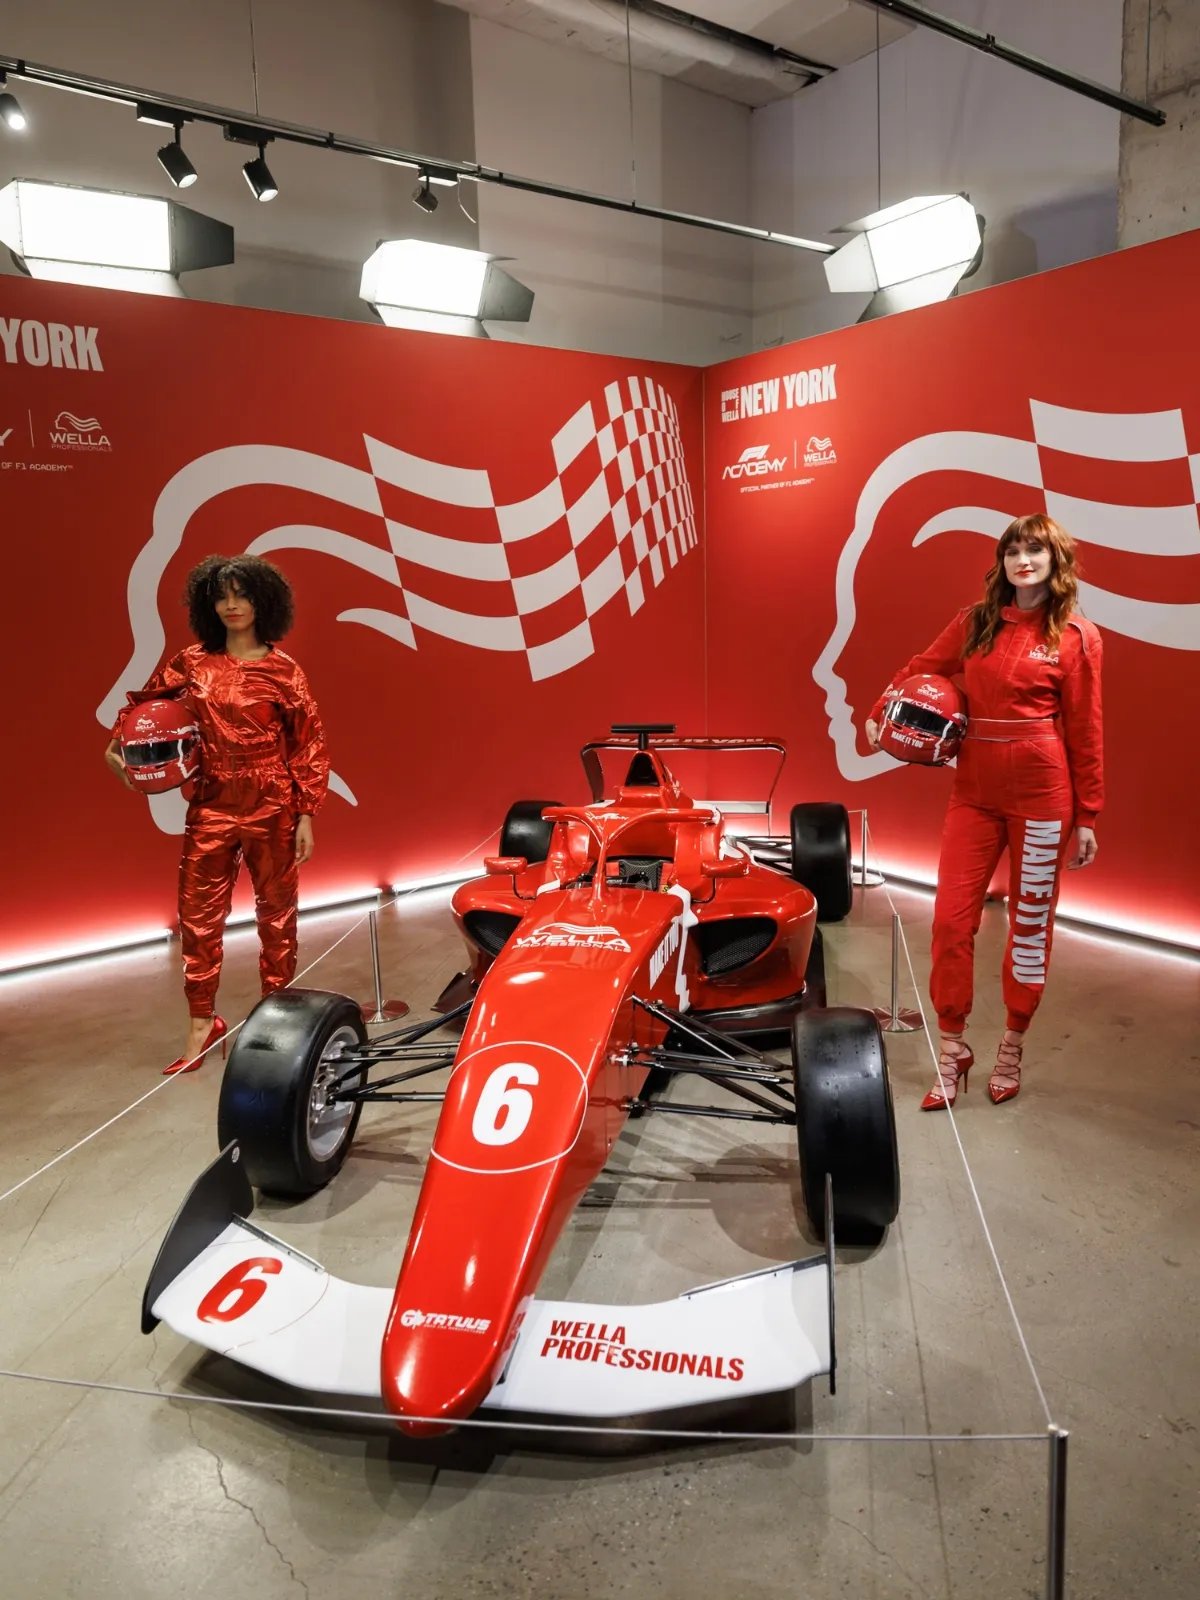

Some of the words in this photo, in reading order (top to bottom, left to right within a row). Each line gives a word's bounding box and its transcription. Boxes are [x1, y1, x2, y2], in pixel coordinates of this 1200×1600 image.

[0, 317, 104, 372] YORK
[740, 378, 780, 419] NEW
[783, 364, 837, 409] YORK
[50, 431, 111, 447] WELLA
[1, 461, 12, 470] OF
[15, 462, 27, 470] F1
[722, 457, 787, 480] ACADEMY
[803, 450, 837, 464] WELLA
[1020, 820, 1062, 898] MAKE
[1015, 901, 1050, 927] IT
[511, 942, 631, 953] PROFESSIONALS
[516, 934, 631, 950] WELLA
[1012, 930, 1047, 984] YOU
[472, 1062, 540, 1146] 6
[197, 1256, 283, 1324] 6
[425, 1312, 492, 1331] TATUUS
[550, 1319, 626, 1345] WELLA
[540, 1338, 744, 1382] PROFESSIONALS
